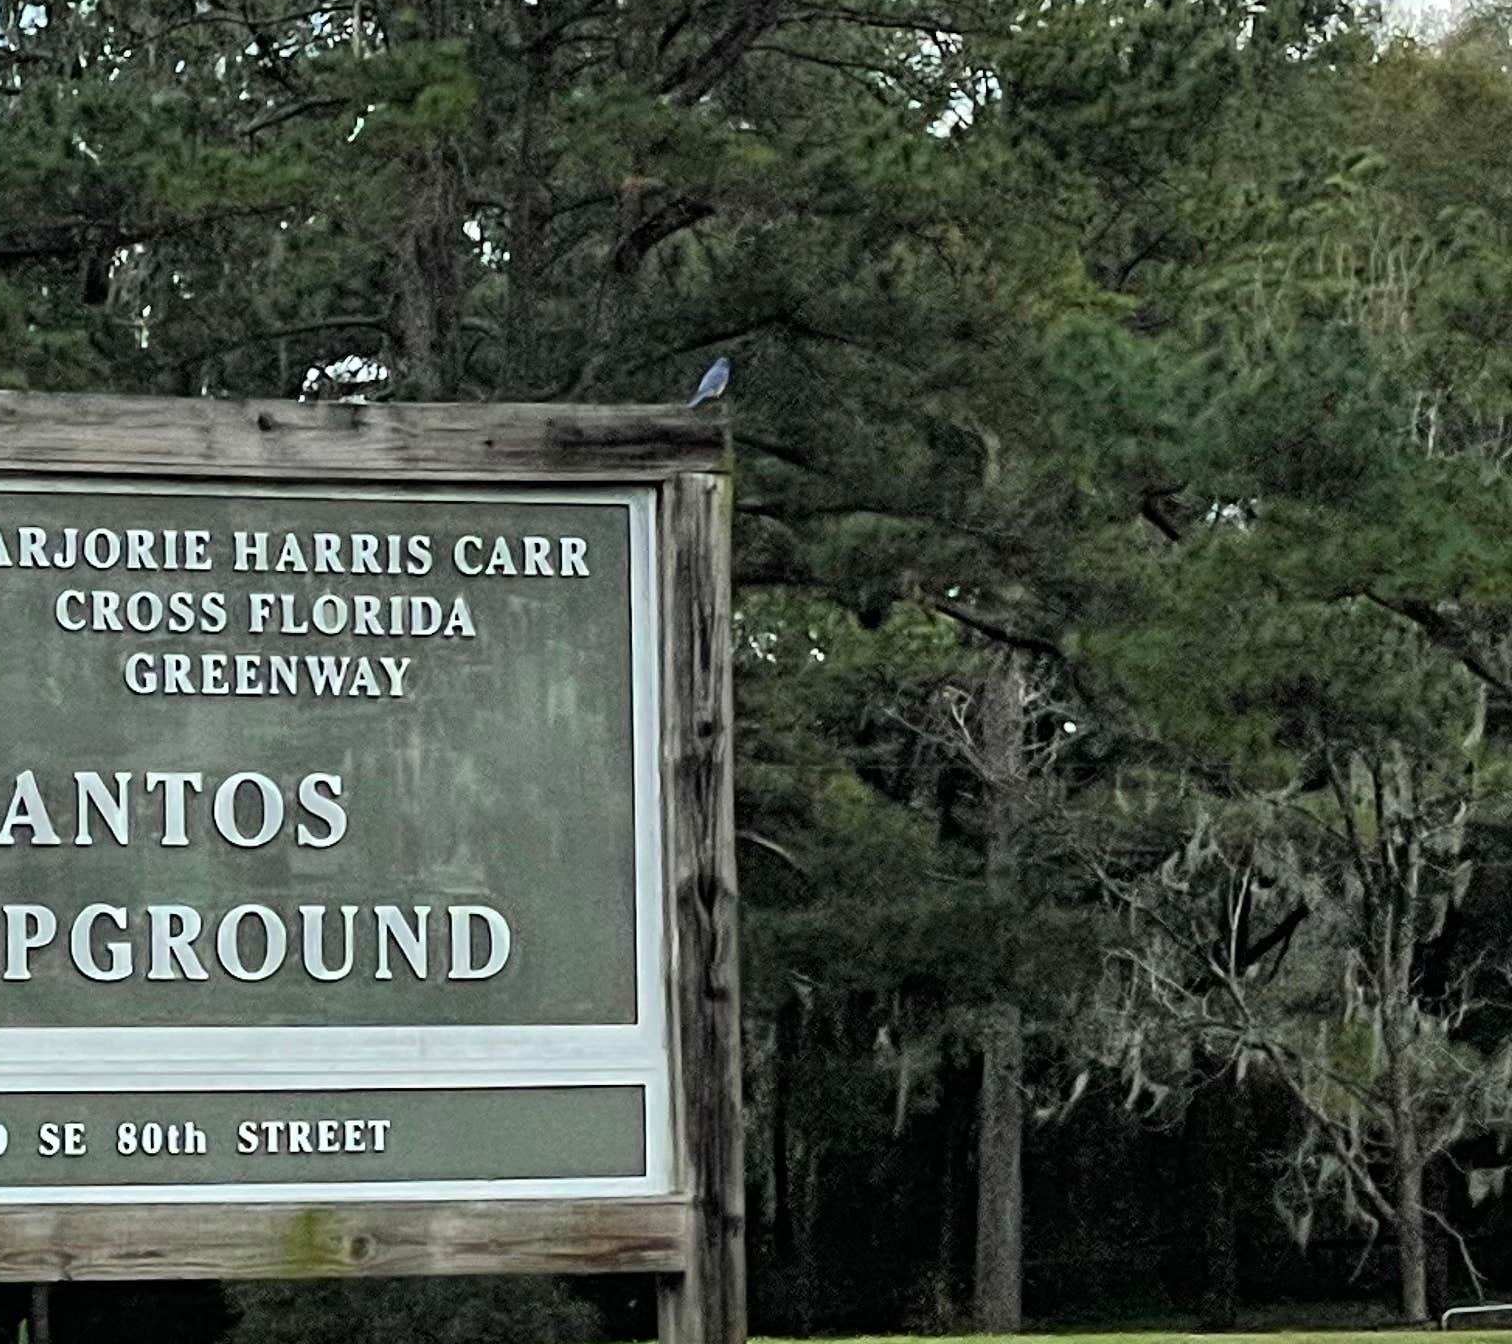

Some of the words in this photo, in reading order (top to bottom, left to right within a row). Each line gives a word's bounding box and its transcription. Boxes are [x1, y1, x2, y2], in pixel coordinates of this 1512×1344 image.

[233, 530, 435, 575] HARRIS
[454, 535, 591, 578] CARR
[54, 589, 228, 635] CROSS
[248, 593, 477, 638] FLORIDA
[124, 653, 412, 697] GREENWAY
[37, 1122, 88, 1156] SE
[116, 1122, 208, 1156] 80th
[236, 1119, 392, 1154] STREET
